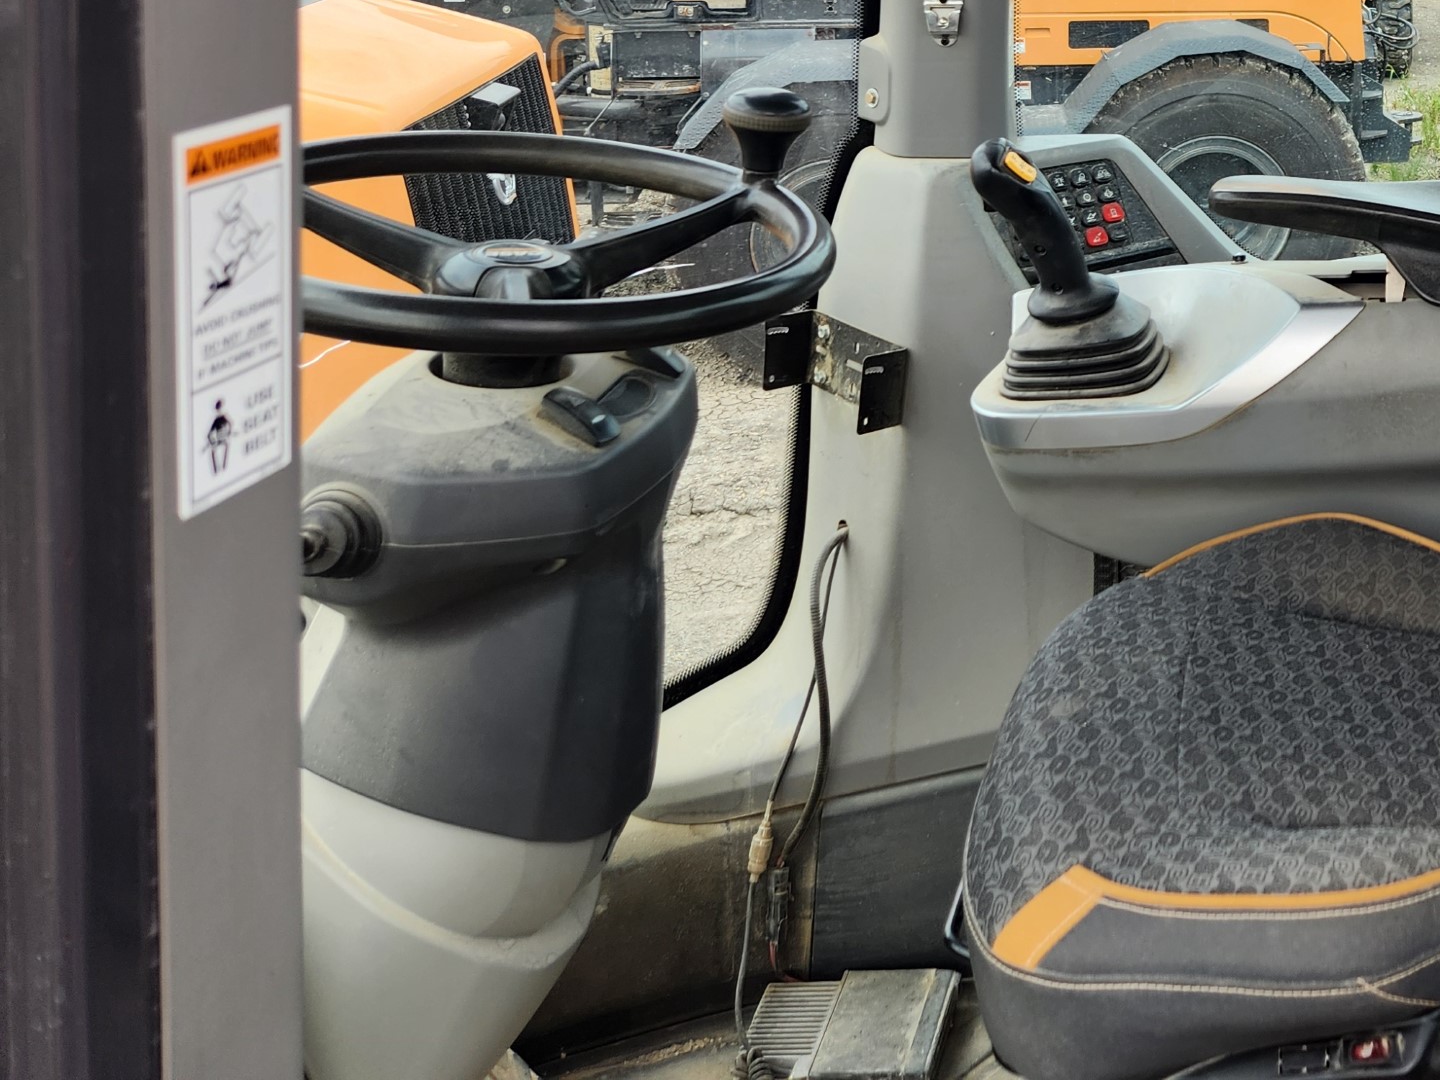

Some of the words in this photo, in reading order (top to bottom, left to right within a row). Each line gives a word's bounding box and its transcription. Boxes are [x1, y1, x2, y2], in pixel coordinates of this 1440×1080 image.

[212, 129, 280, 170] WARNING
[195, 313, 228, 336] AVOID
[247, 384, 274, 409] USE
[243, 403, 279, 434] SEAT
[244, 426, 277, 457] BELT
